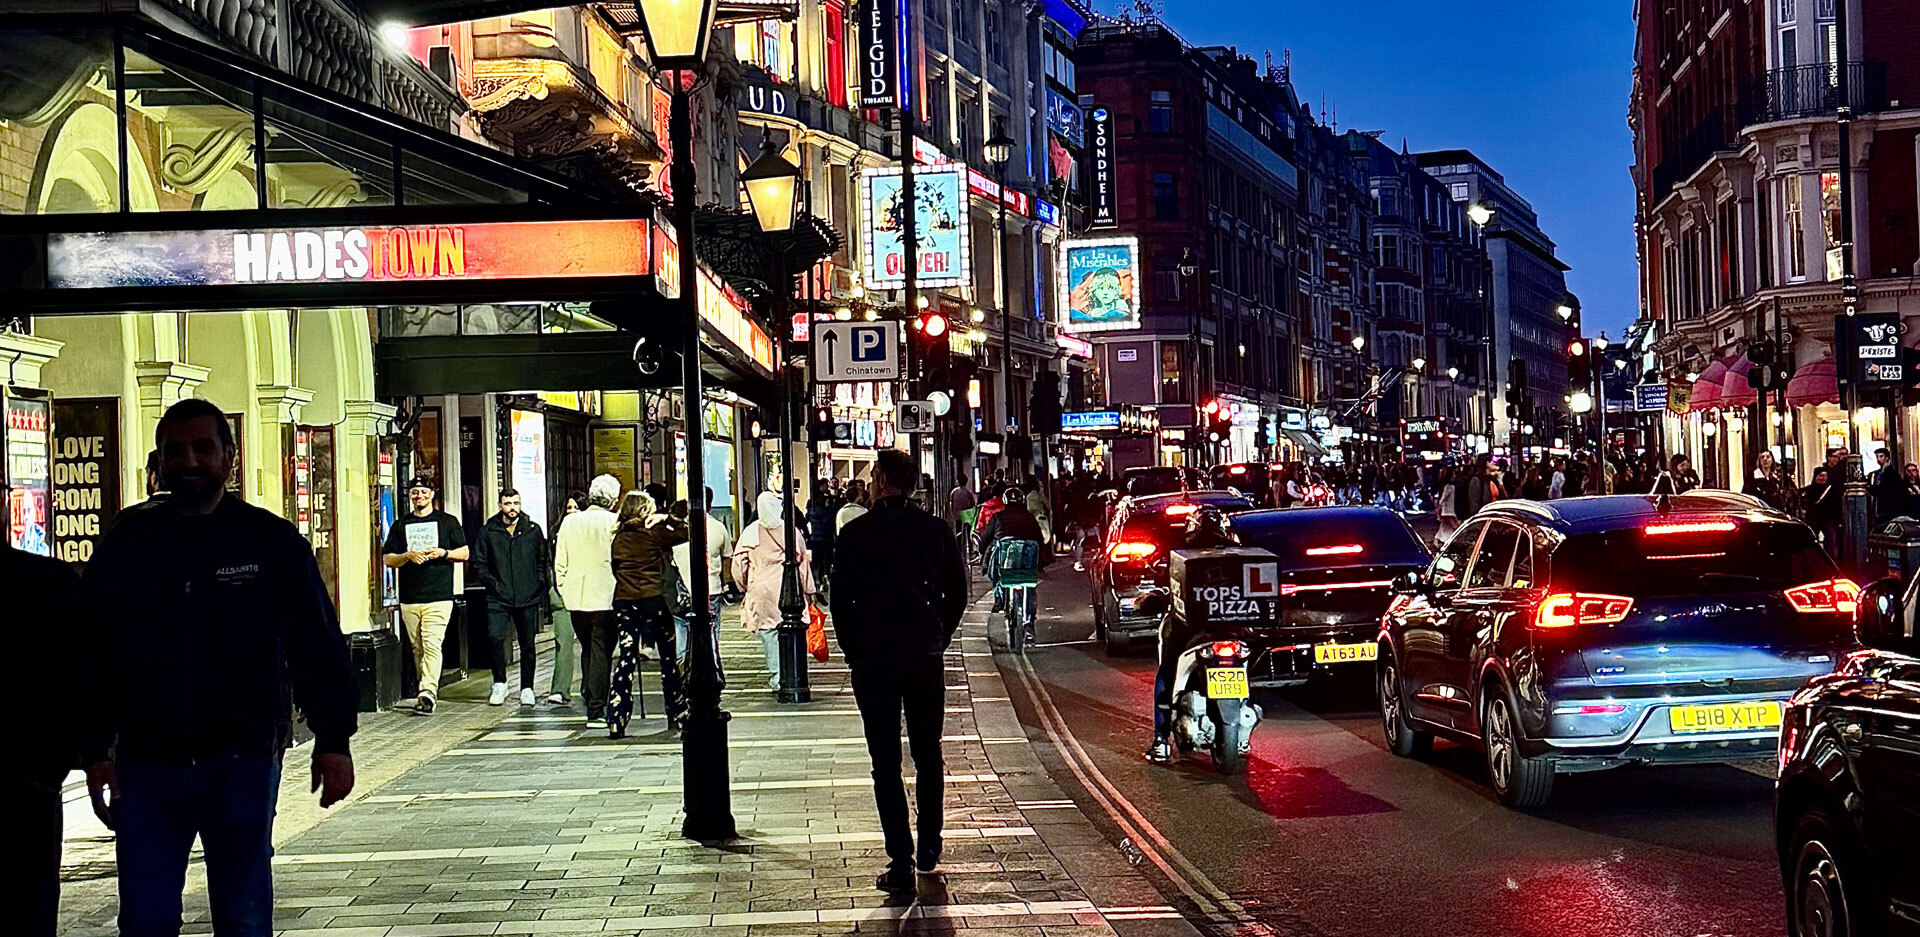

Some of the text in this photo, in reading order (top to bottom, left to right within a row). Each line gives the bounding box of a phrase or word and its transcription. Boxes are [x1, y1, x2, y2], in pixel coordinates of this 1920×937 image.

[863, 96, 893, 104] THEATRE
[1096, 123, 1109, 217] SONDHEIM
[233, 228, 465, 283] HADESTOWN
[1092, 250, 1105, 260] Les
[886, 252, 949, 275] OLVER!
[858, 330, 880, 358] P
[845, 366, 891, 376] Chinatown
[54, 436, 105, 459] LOVE
[1193, 586, 1240, 601] TOPS
[1208, 600, 1260, 615] PIZZA
[1322, 648, 1355, 661] AT63
[1208, 671, 1245, 683] KS20
[1214, 683, 1242, 695] URB
[1683, 706, 1767, 727] LB18 XTP
